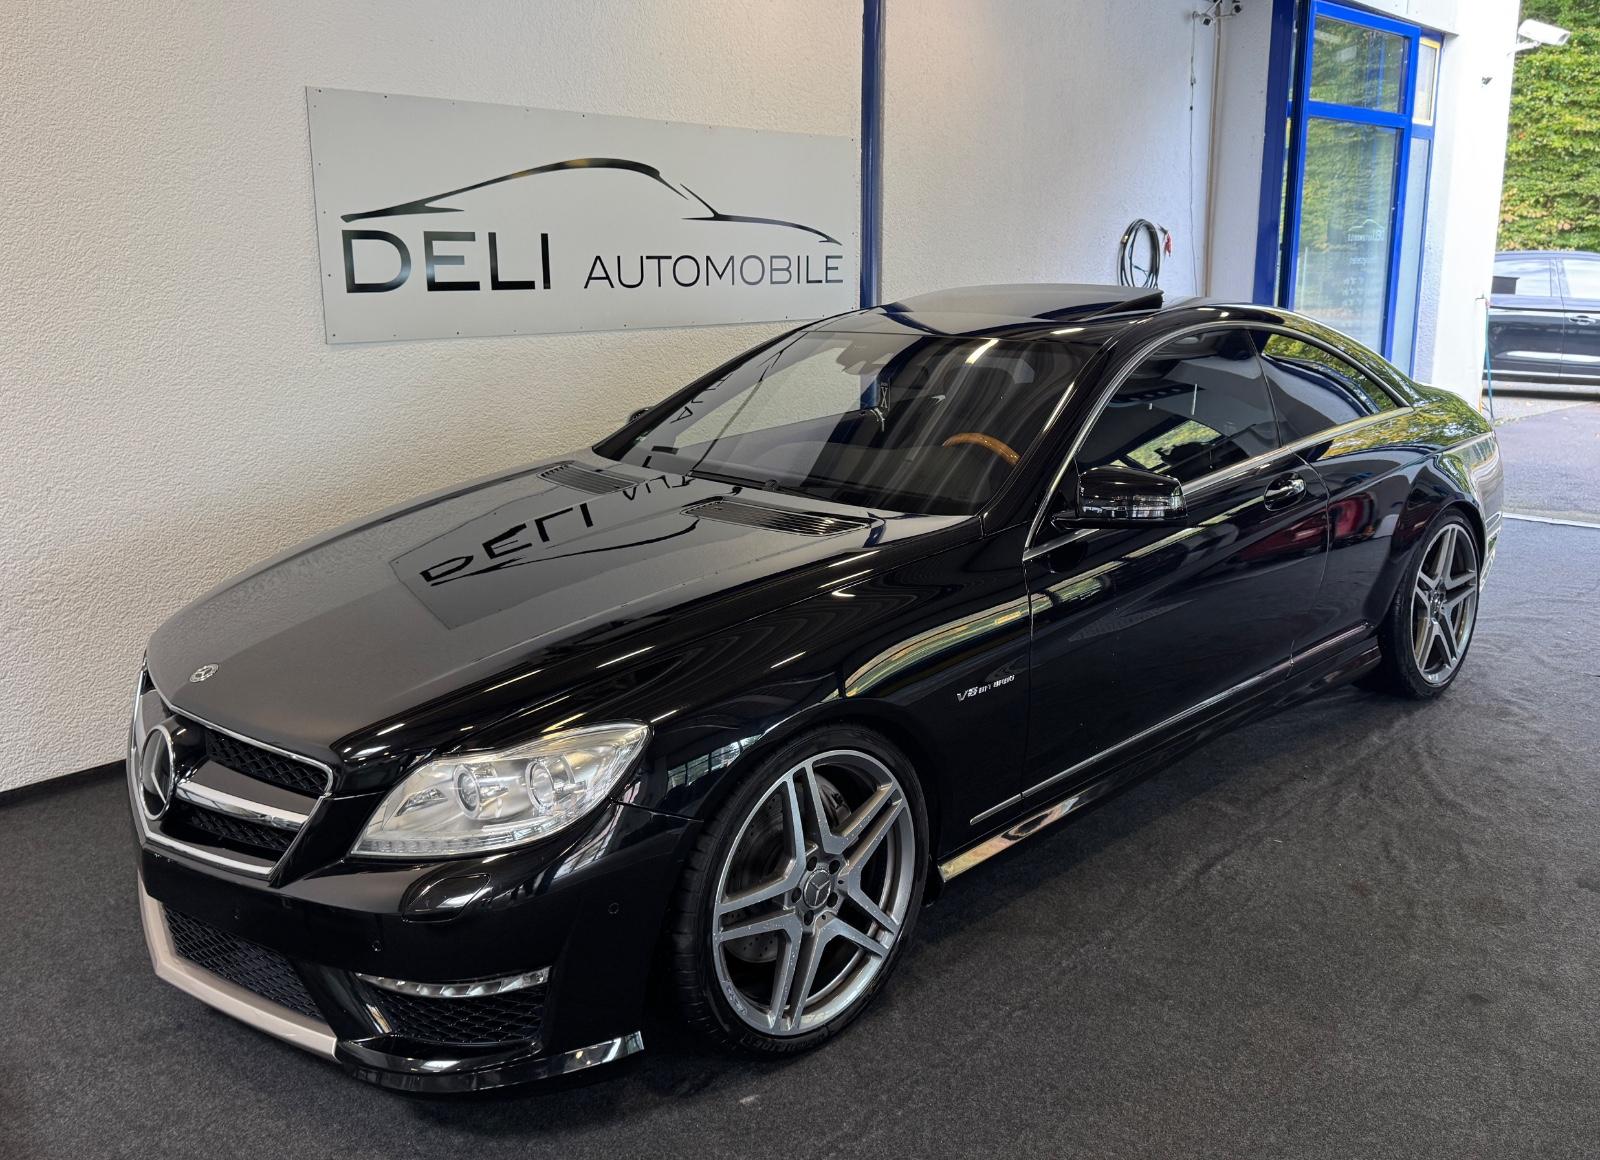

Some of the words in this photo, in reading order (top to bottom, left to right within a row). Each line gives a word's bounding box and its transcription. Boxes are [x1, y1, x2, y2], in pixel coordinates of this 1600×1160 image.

[341, 229, 551, 294] DELI
[583, 254, 844, 290] AUTOMOBILE
[956, 686, 979, 702] V8
